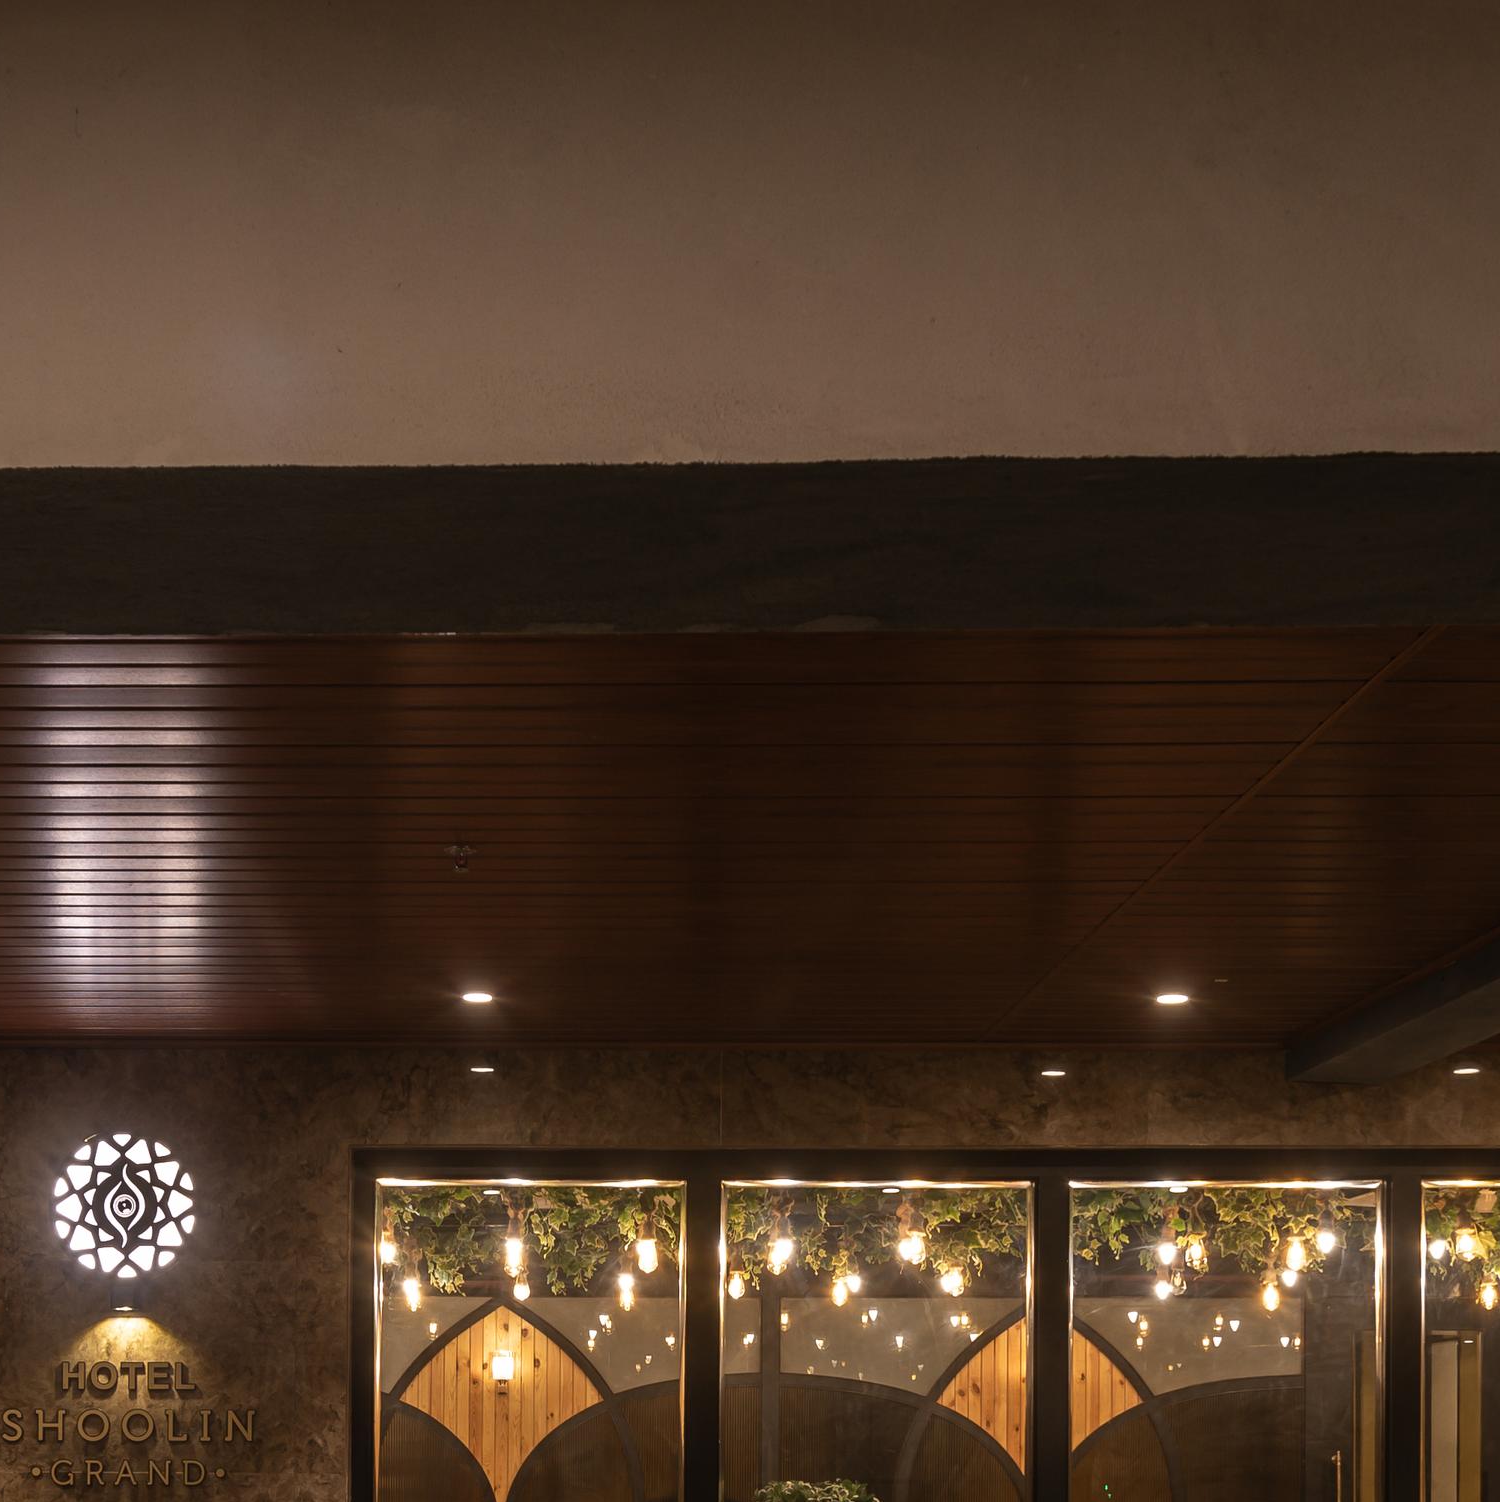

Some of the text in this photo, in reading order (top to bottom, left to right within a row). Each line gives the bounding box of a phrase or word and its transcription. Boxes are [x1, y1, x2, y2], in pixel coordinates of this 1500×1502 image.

[61, 1360, 197, 1391] HOTEL
[1, 1408, 256, 1442] SHOOLIN
[50, 1459, 206, 1487] GRAND
